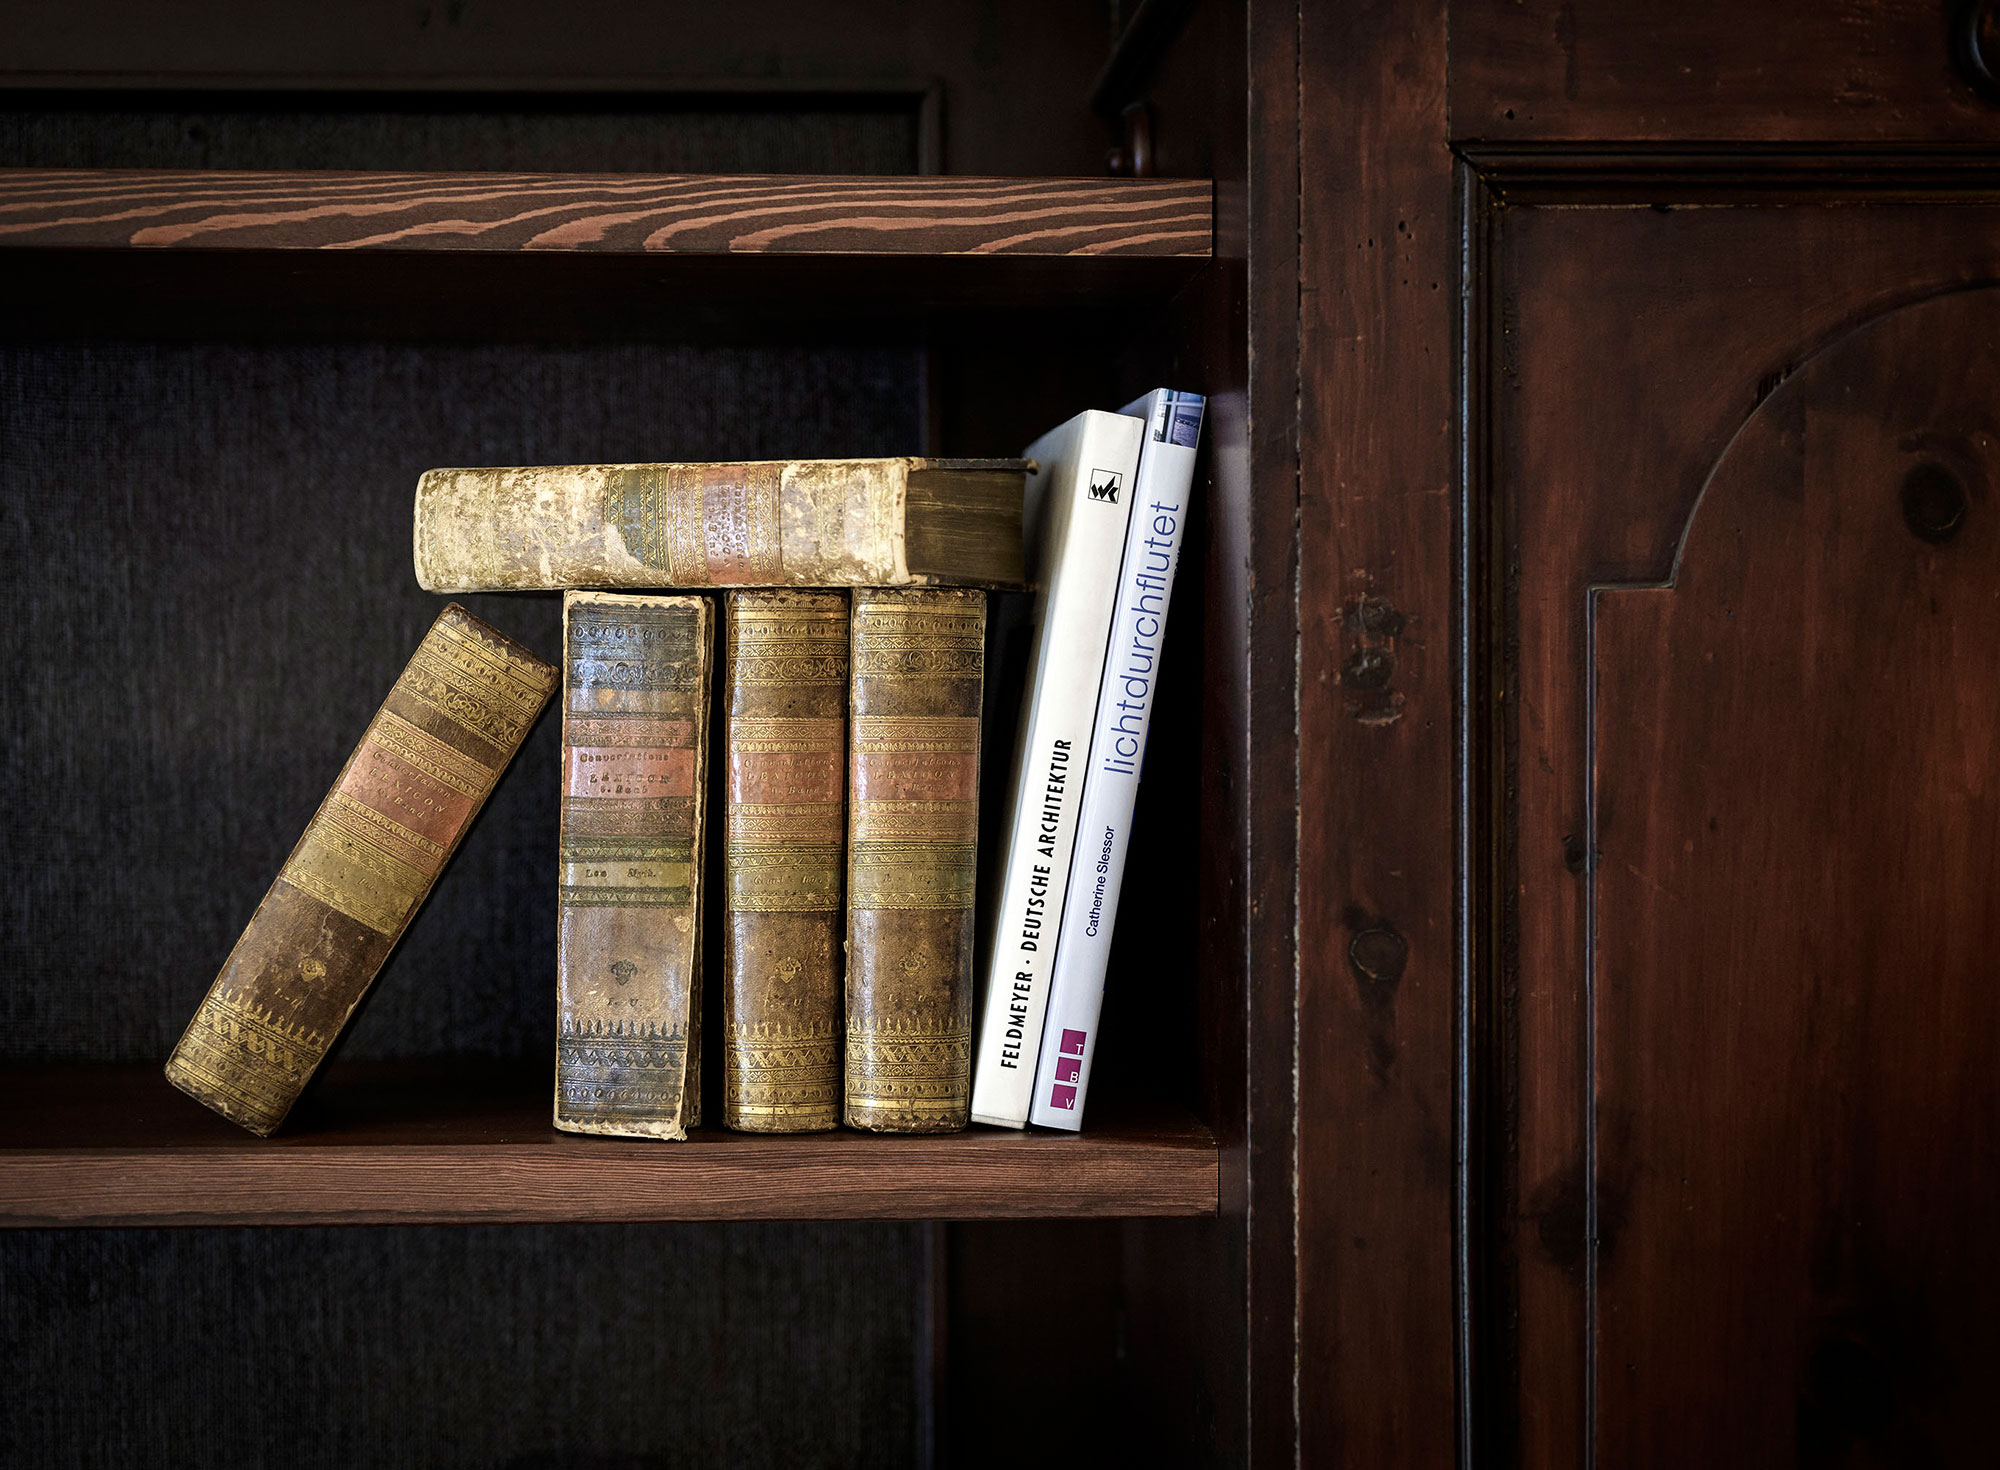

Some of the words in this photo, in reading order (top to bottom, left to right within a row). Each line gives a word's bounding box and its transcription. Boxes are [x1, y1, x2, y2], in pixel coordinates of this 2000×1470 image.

[1103, 500, 1180, 776] lichtdurchflutet
[1000, 971, 1034, 1069] FELDMEYER
[1020, 864, 1051, 952] DEUTSCHE
[1037, 739, 1072, 858] ARCHITEKTUR
[1085, 875, 1107, 938] Catherine
[1096, 825, 1115, 874] Slessor
